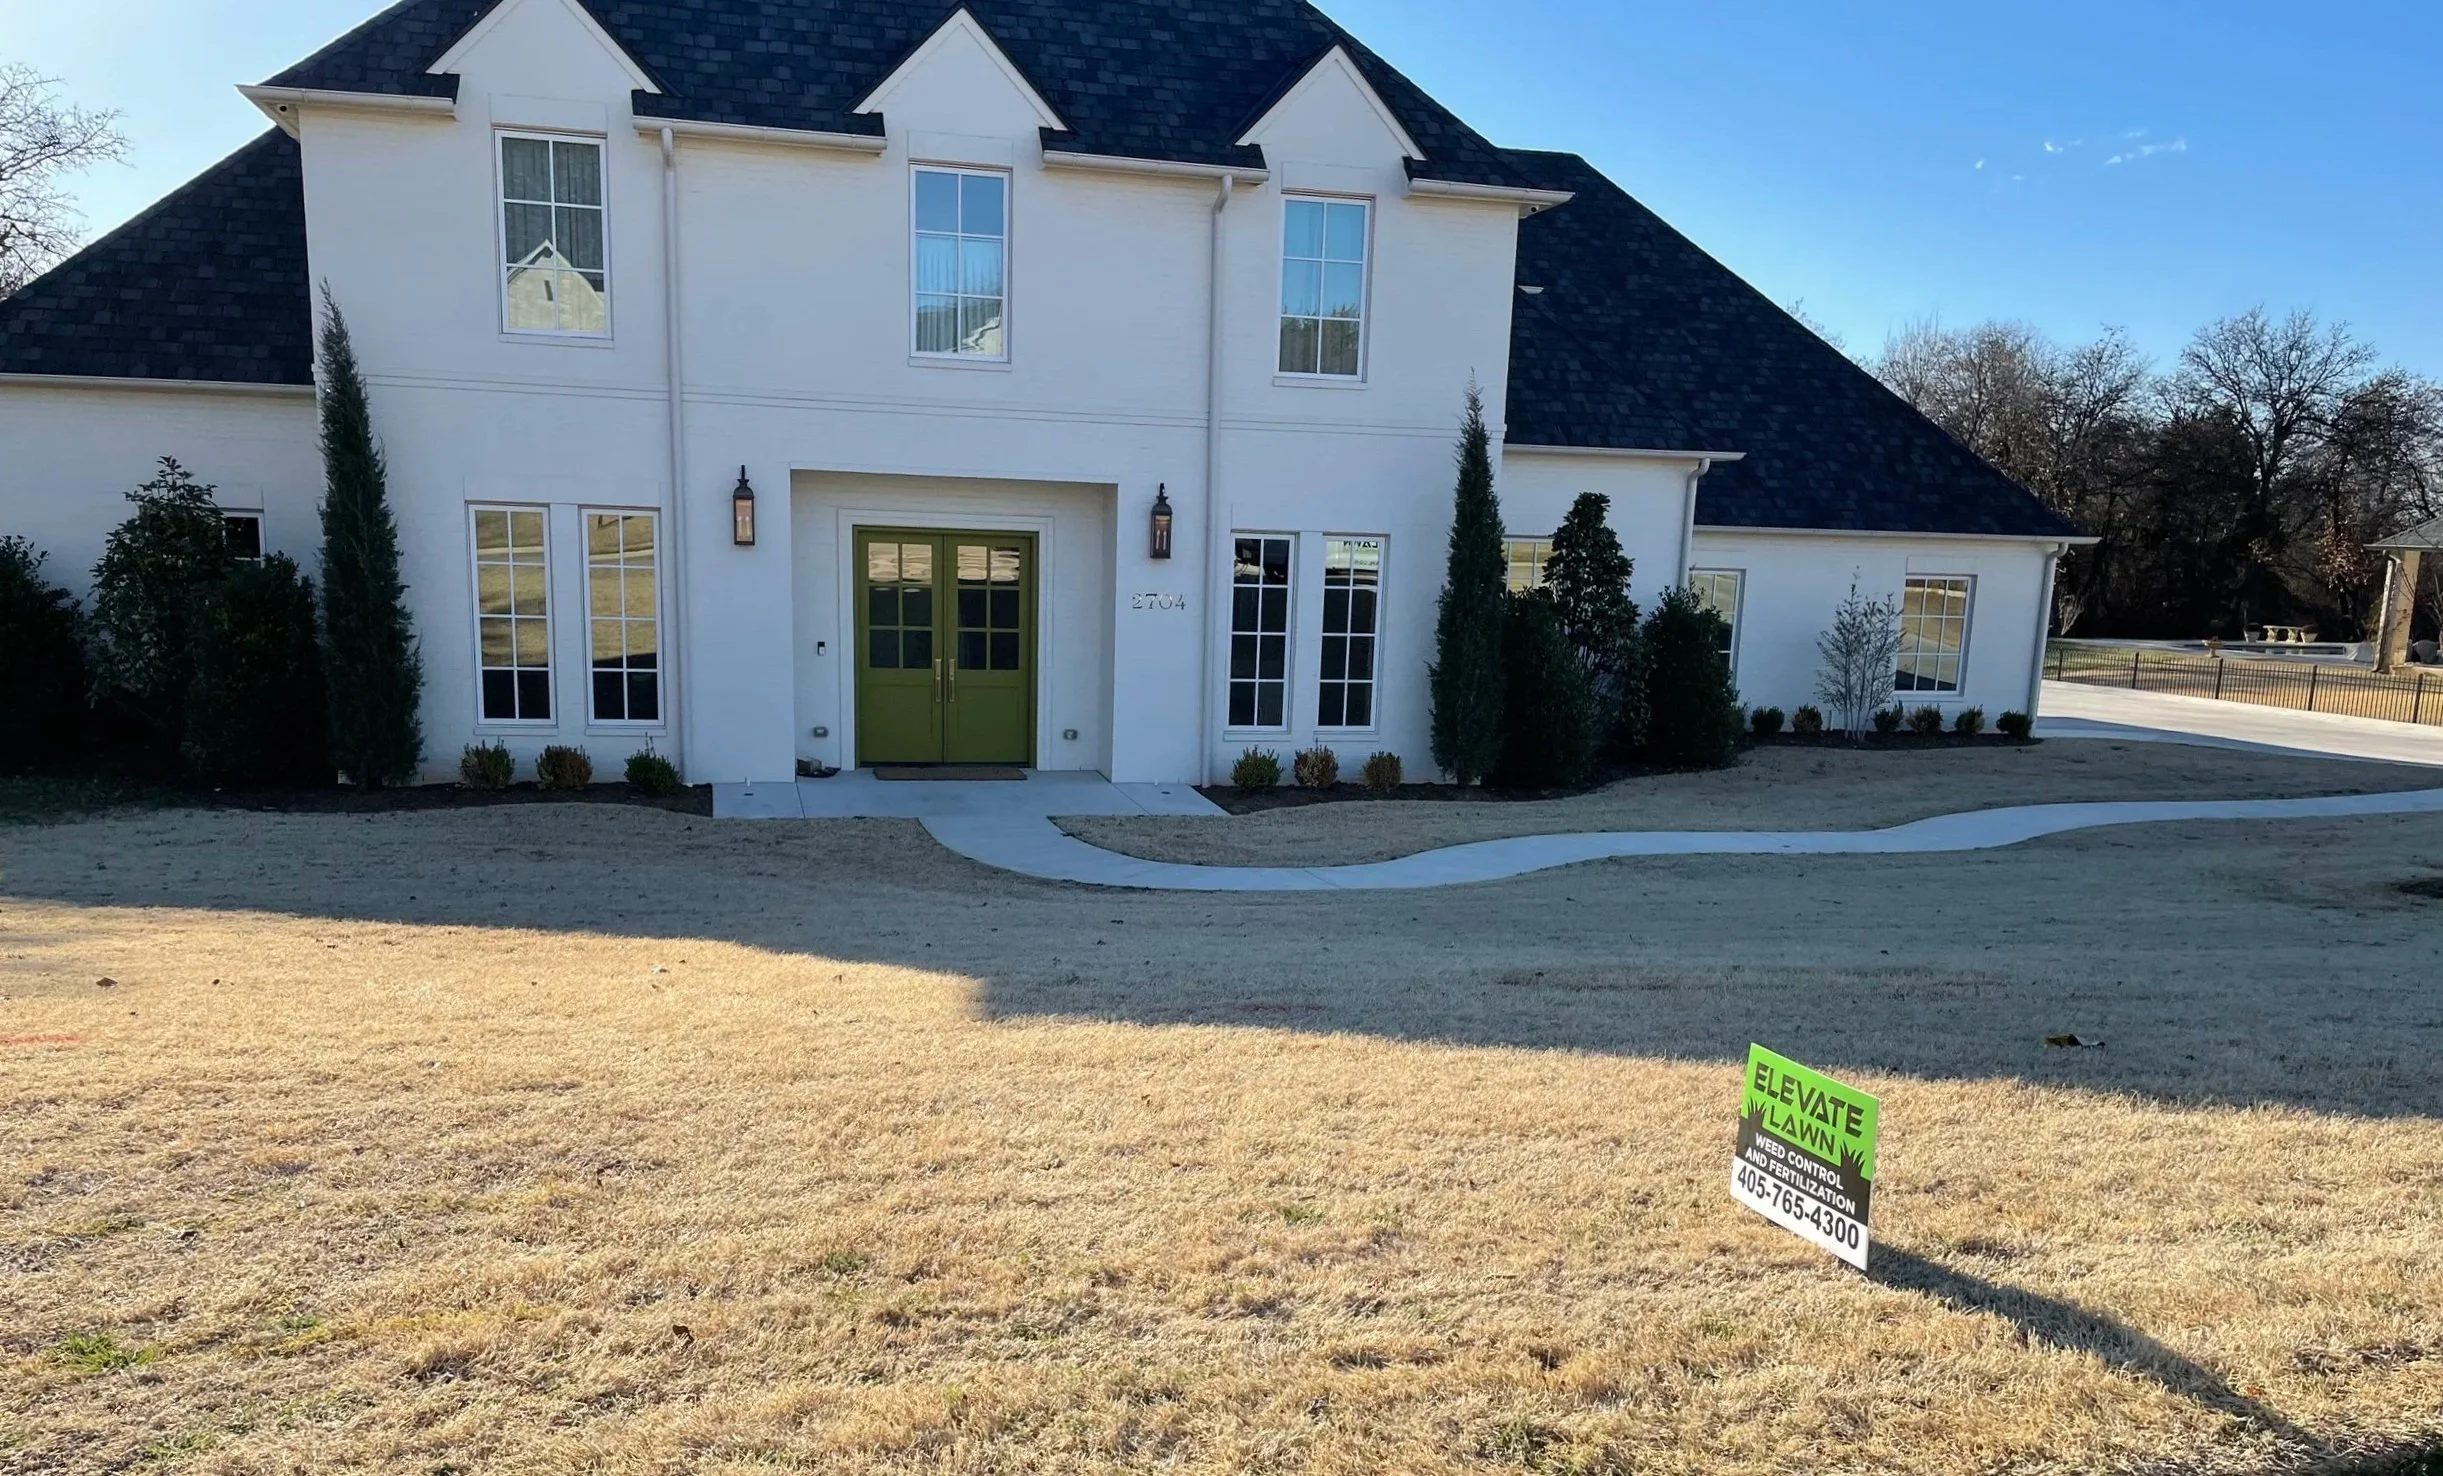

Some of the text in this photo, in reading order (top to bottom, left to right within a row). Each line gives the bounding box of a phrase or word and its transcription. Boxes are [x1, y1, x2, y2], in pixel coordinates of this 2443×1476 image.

[1132, 593, 1186, 610] 2704
[1753, 1061, 1865, 1139] ELEVATE
[1769, 1105, 1836, 1156] LAWN
[1745, 1147, 1856, 1216] AND FERTILIZATION
[1755, 1132, 1844, 1190] WEED CONTROL
[1737, 1165, 1860, 1250] 405-765-4300
